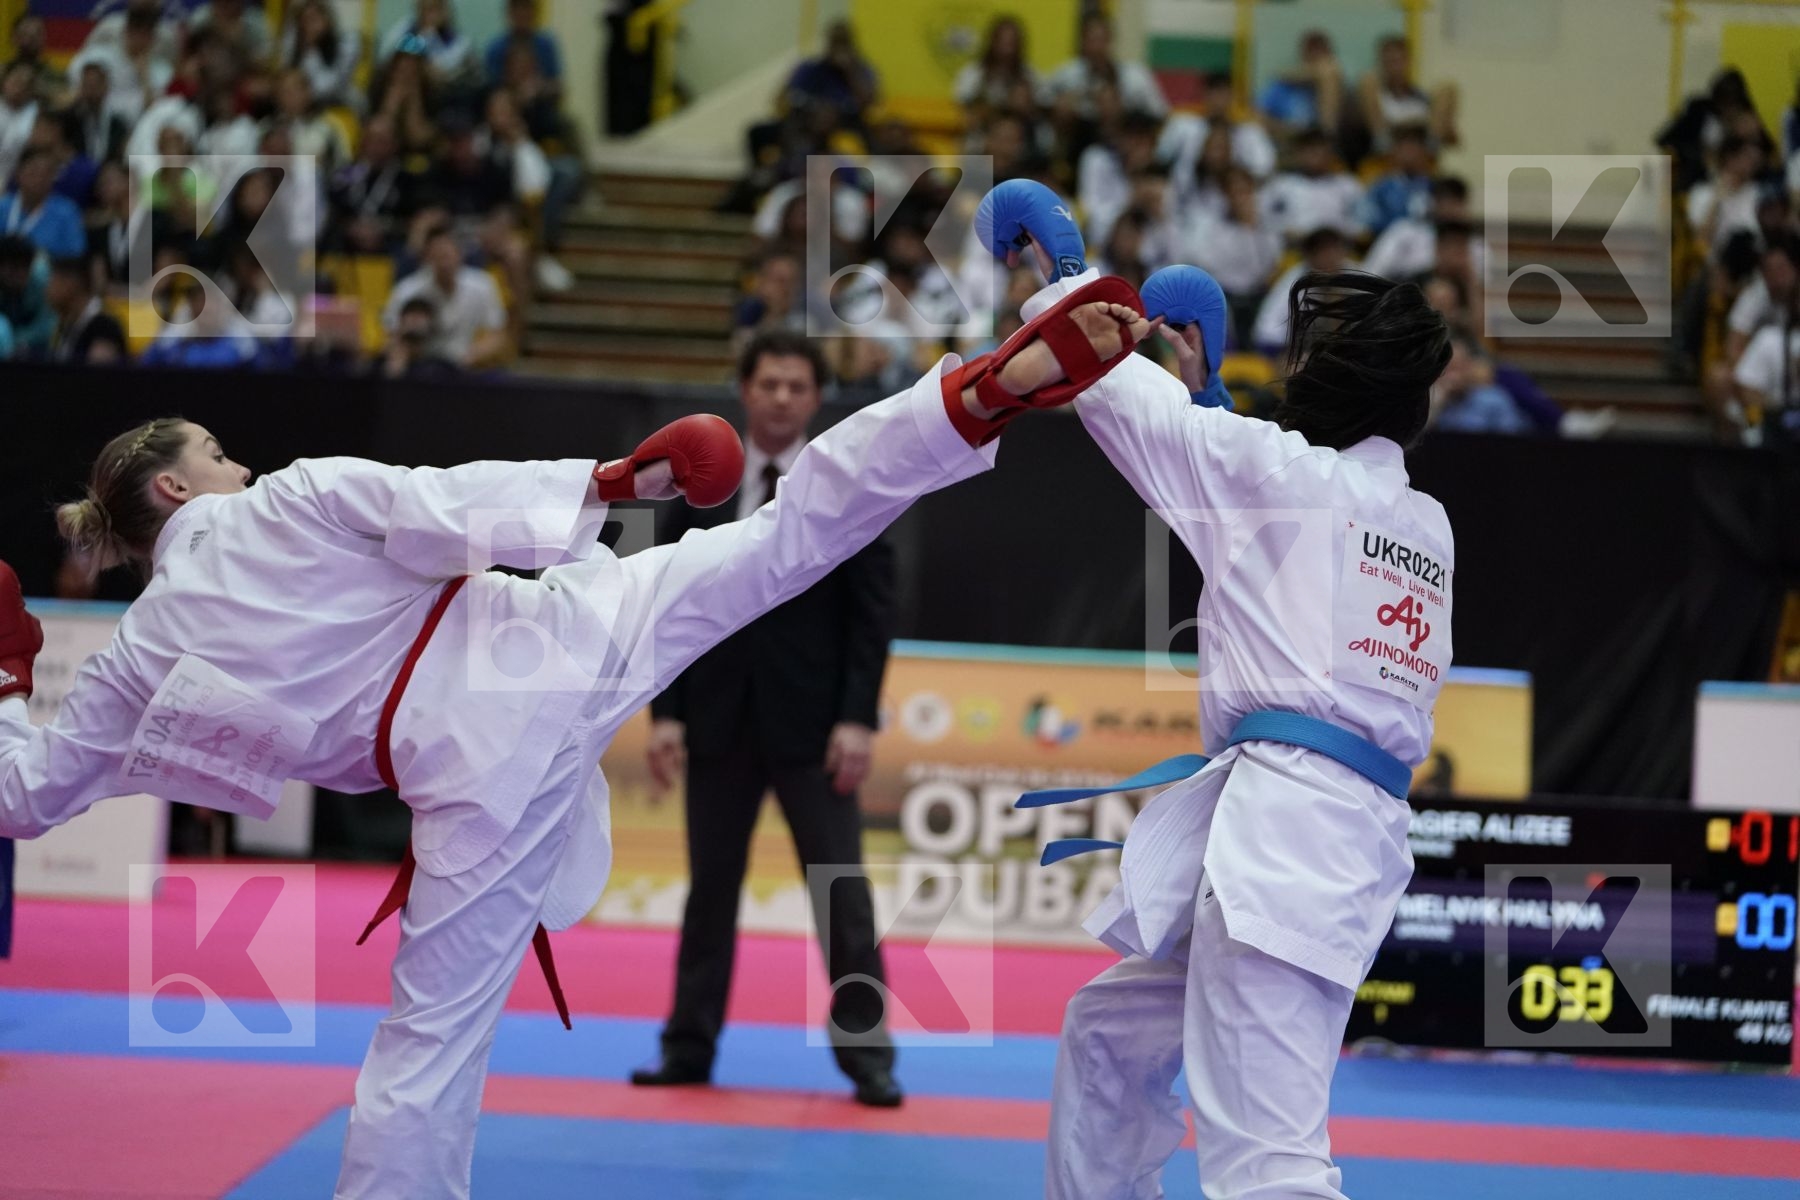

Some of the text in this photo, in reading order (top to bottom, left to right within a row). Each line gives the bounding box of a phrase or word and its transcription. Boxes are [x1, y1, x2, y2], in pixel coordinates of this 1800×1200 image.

[1359, 561, 1379, 578] Eat
[1383, 567, 1405, 589] Well,
[1408, 579, 1426, 598] Live
[1363, 531, 1446, 593] UKR0221
[1348, 637, 1439, 682] AJINOMOTO
[1736, 892, 1796, 950] 00
